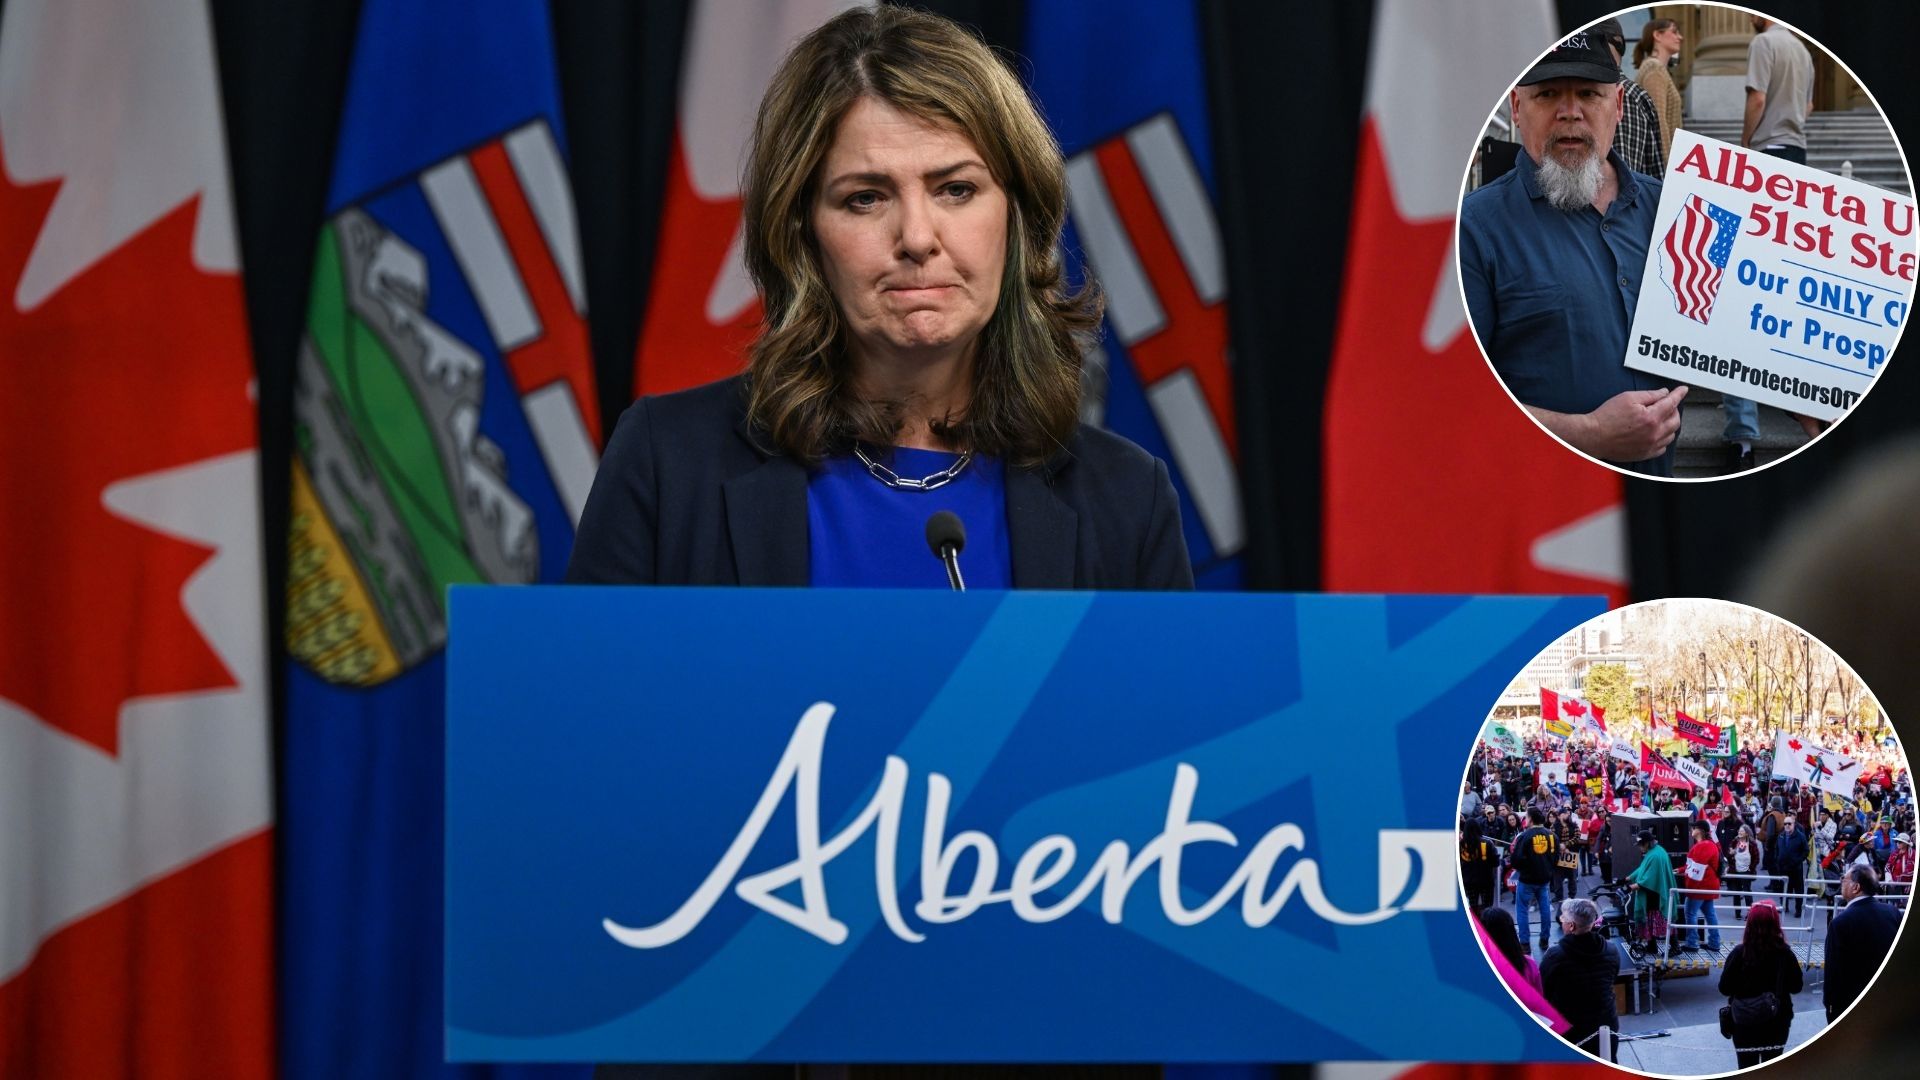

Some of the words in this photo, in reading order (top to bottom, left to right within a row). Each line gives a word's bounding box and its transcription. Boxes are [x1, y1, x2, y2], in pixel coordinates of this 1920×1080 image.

[1675, 143, 1868, 226] Alberta
[1746, 203, 1836, 259] 51st
[1737, 259, 1789, 294] Our
[1798, 276, 1874, 318] ONLY
[1750, 303, 1793, 339] for
[1803, 317, 1891, 370] Prosp
[1656, 767, 1681, 779] UNA
[1682, 761, 1701, 777] UNA
[603, 701, 1404, 949] Alberta
